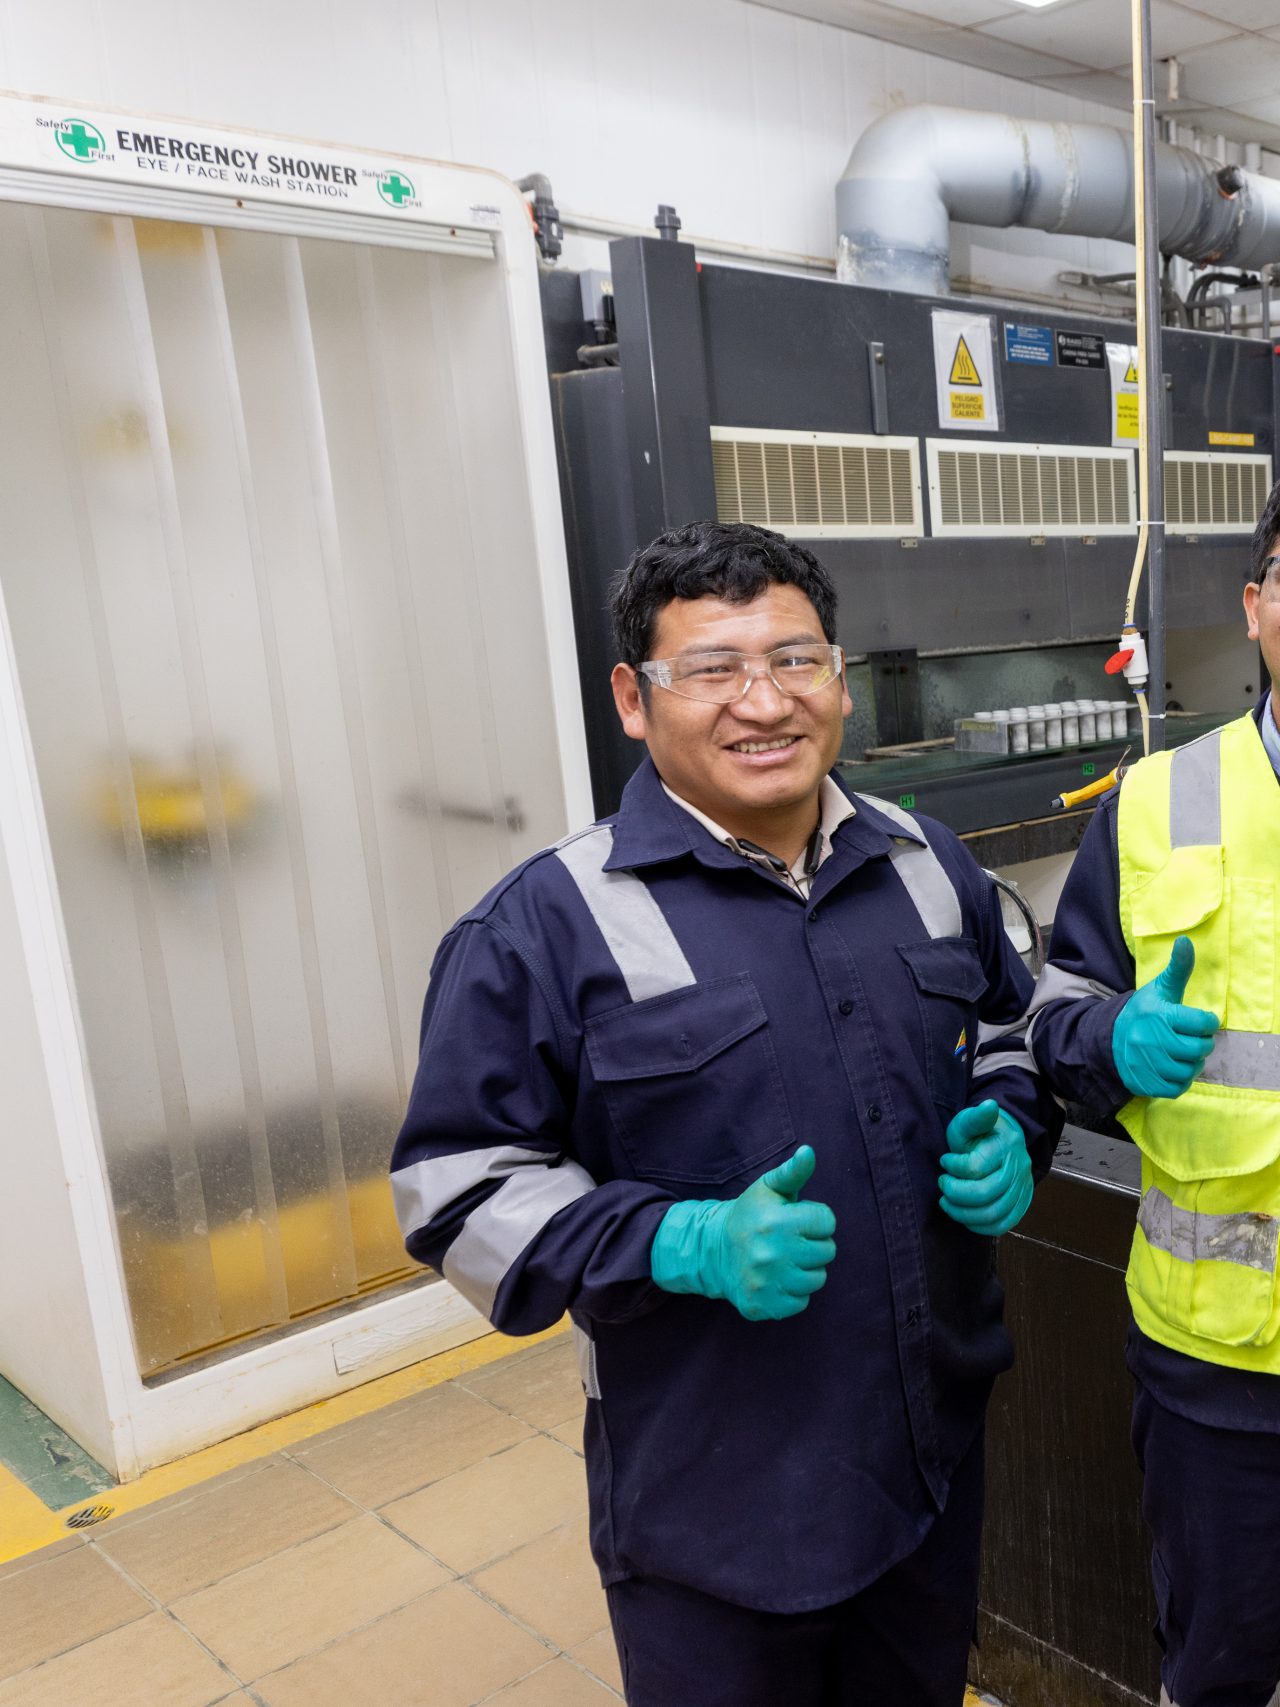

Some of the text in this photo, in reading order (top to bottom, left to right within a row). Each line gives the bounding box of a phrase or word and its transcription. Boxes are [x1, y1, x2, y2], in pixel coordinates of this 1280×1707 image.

[35, 117, 70, 132] Safety
[90, 150, 116, 162] First
[116, 129, 358, 187] EMERGENCY SHOWER
[137, 156, 349, 198] EYE / FACE WASH STATION
[361, 168, 388, 181] Safety
[403, 198, 422, 208] First
[954, 394, 979, 403] PELIGRO
[952, 402, 983, 411] SUPERFICIE
[954, 410, 981, 418] CALIENTE
[1084, 764, 1094, 773] H2
[901, 796, 912, 806] H1
